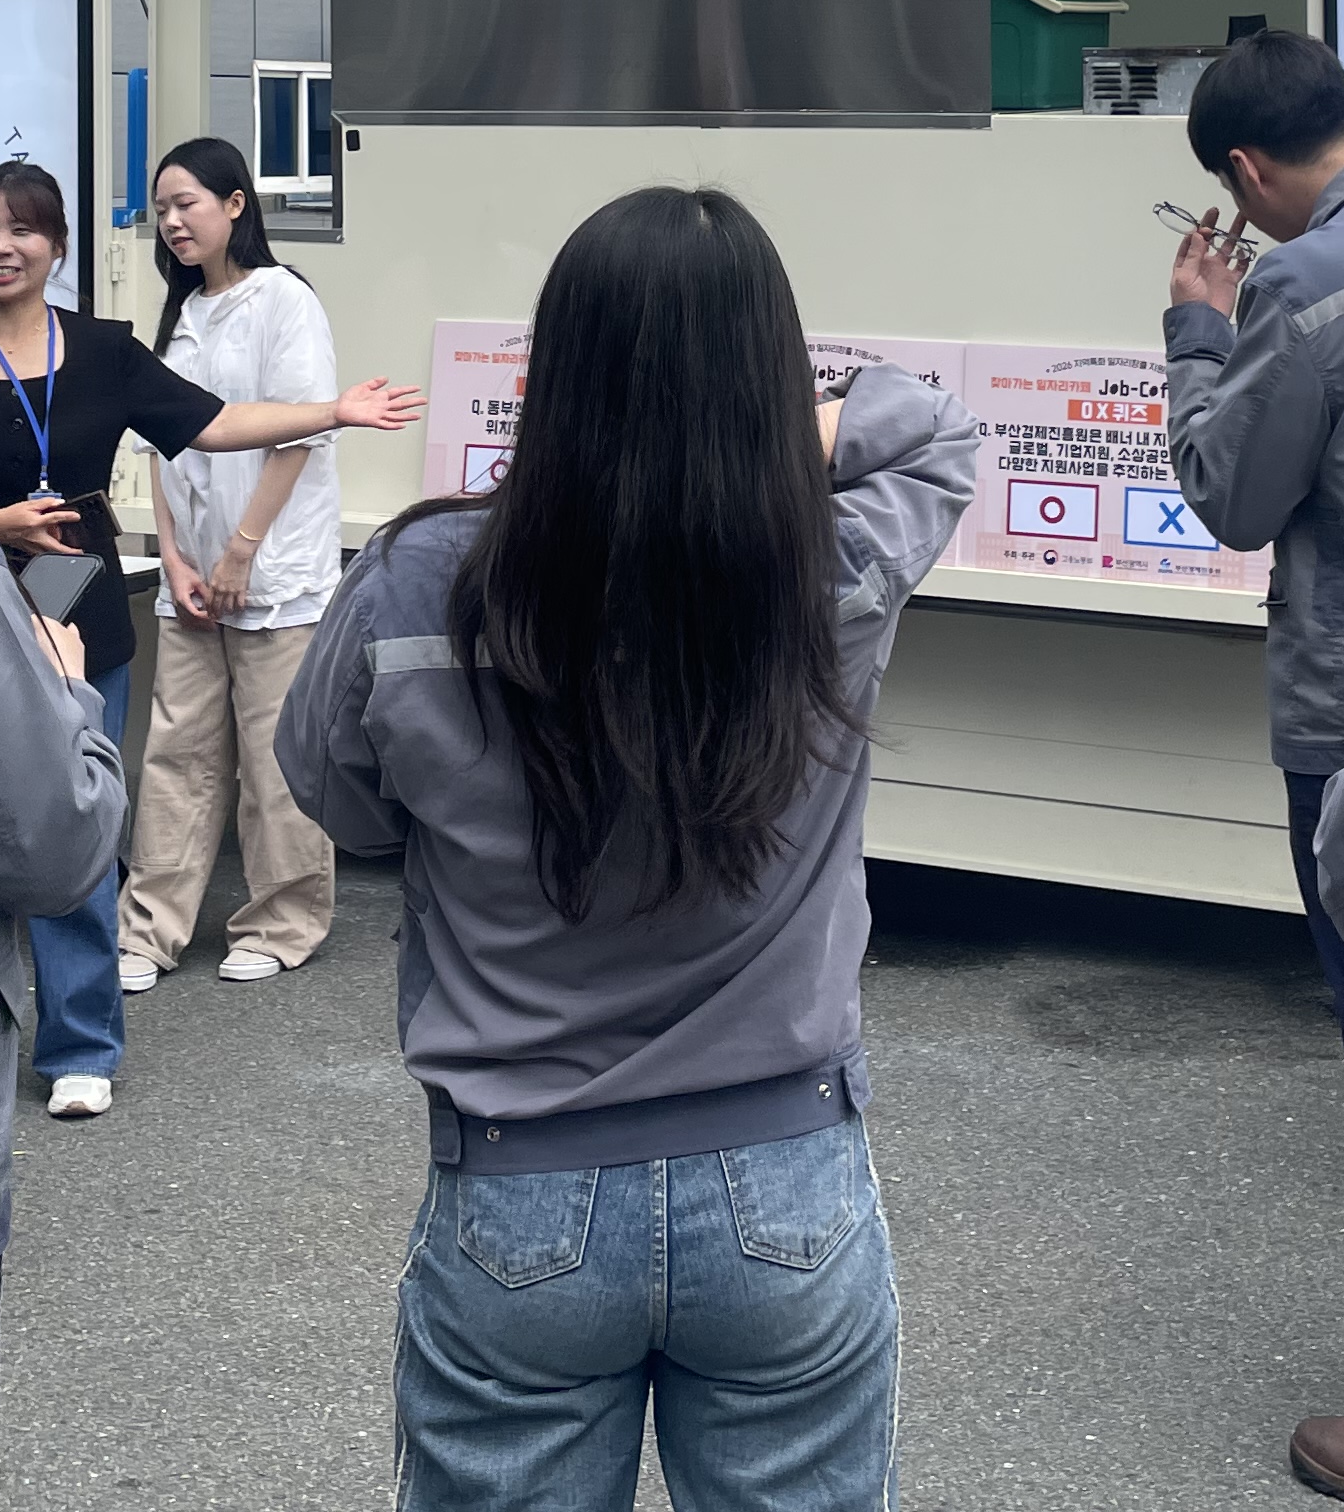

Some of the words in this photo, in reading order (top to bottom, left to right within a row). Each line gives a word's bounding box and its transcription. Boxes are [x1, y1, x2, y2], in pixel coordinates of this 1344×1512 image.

[854, 348, 883, 363] 지원사업
[1051, 362, 1073, 373] 2026
[1108, 357, 1146, 369] 일자리창출
[1149, 361, 1166, 374] 지원
[991, 377, 1032, 389] 찾아가는
[1036, 379, 1091, 393] 일자리카페
[1099, 379, 1168, 398] Job-Cof
[472, 399, 484, 415] Q.
[979, 423, 991, 436] Q.
[995, 423, 1101, 443] 부산경제진흥원은
[1106, 430, 1132, 445] 배너
[1136, 432, 1149, 446] 내
[1153, 433, 1166, 447] 지
[1009, 441, 1052, 457] 글로벌,
[1057, 444, 1114, 462] 기업지원,
[999, 457, 1038, 472] 다양한
[1041, 459, 1108, 477] 지원사업을
[1112, 464, 1167, 481] 추진하는
